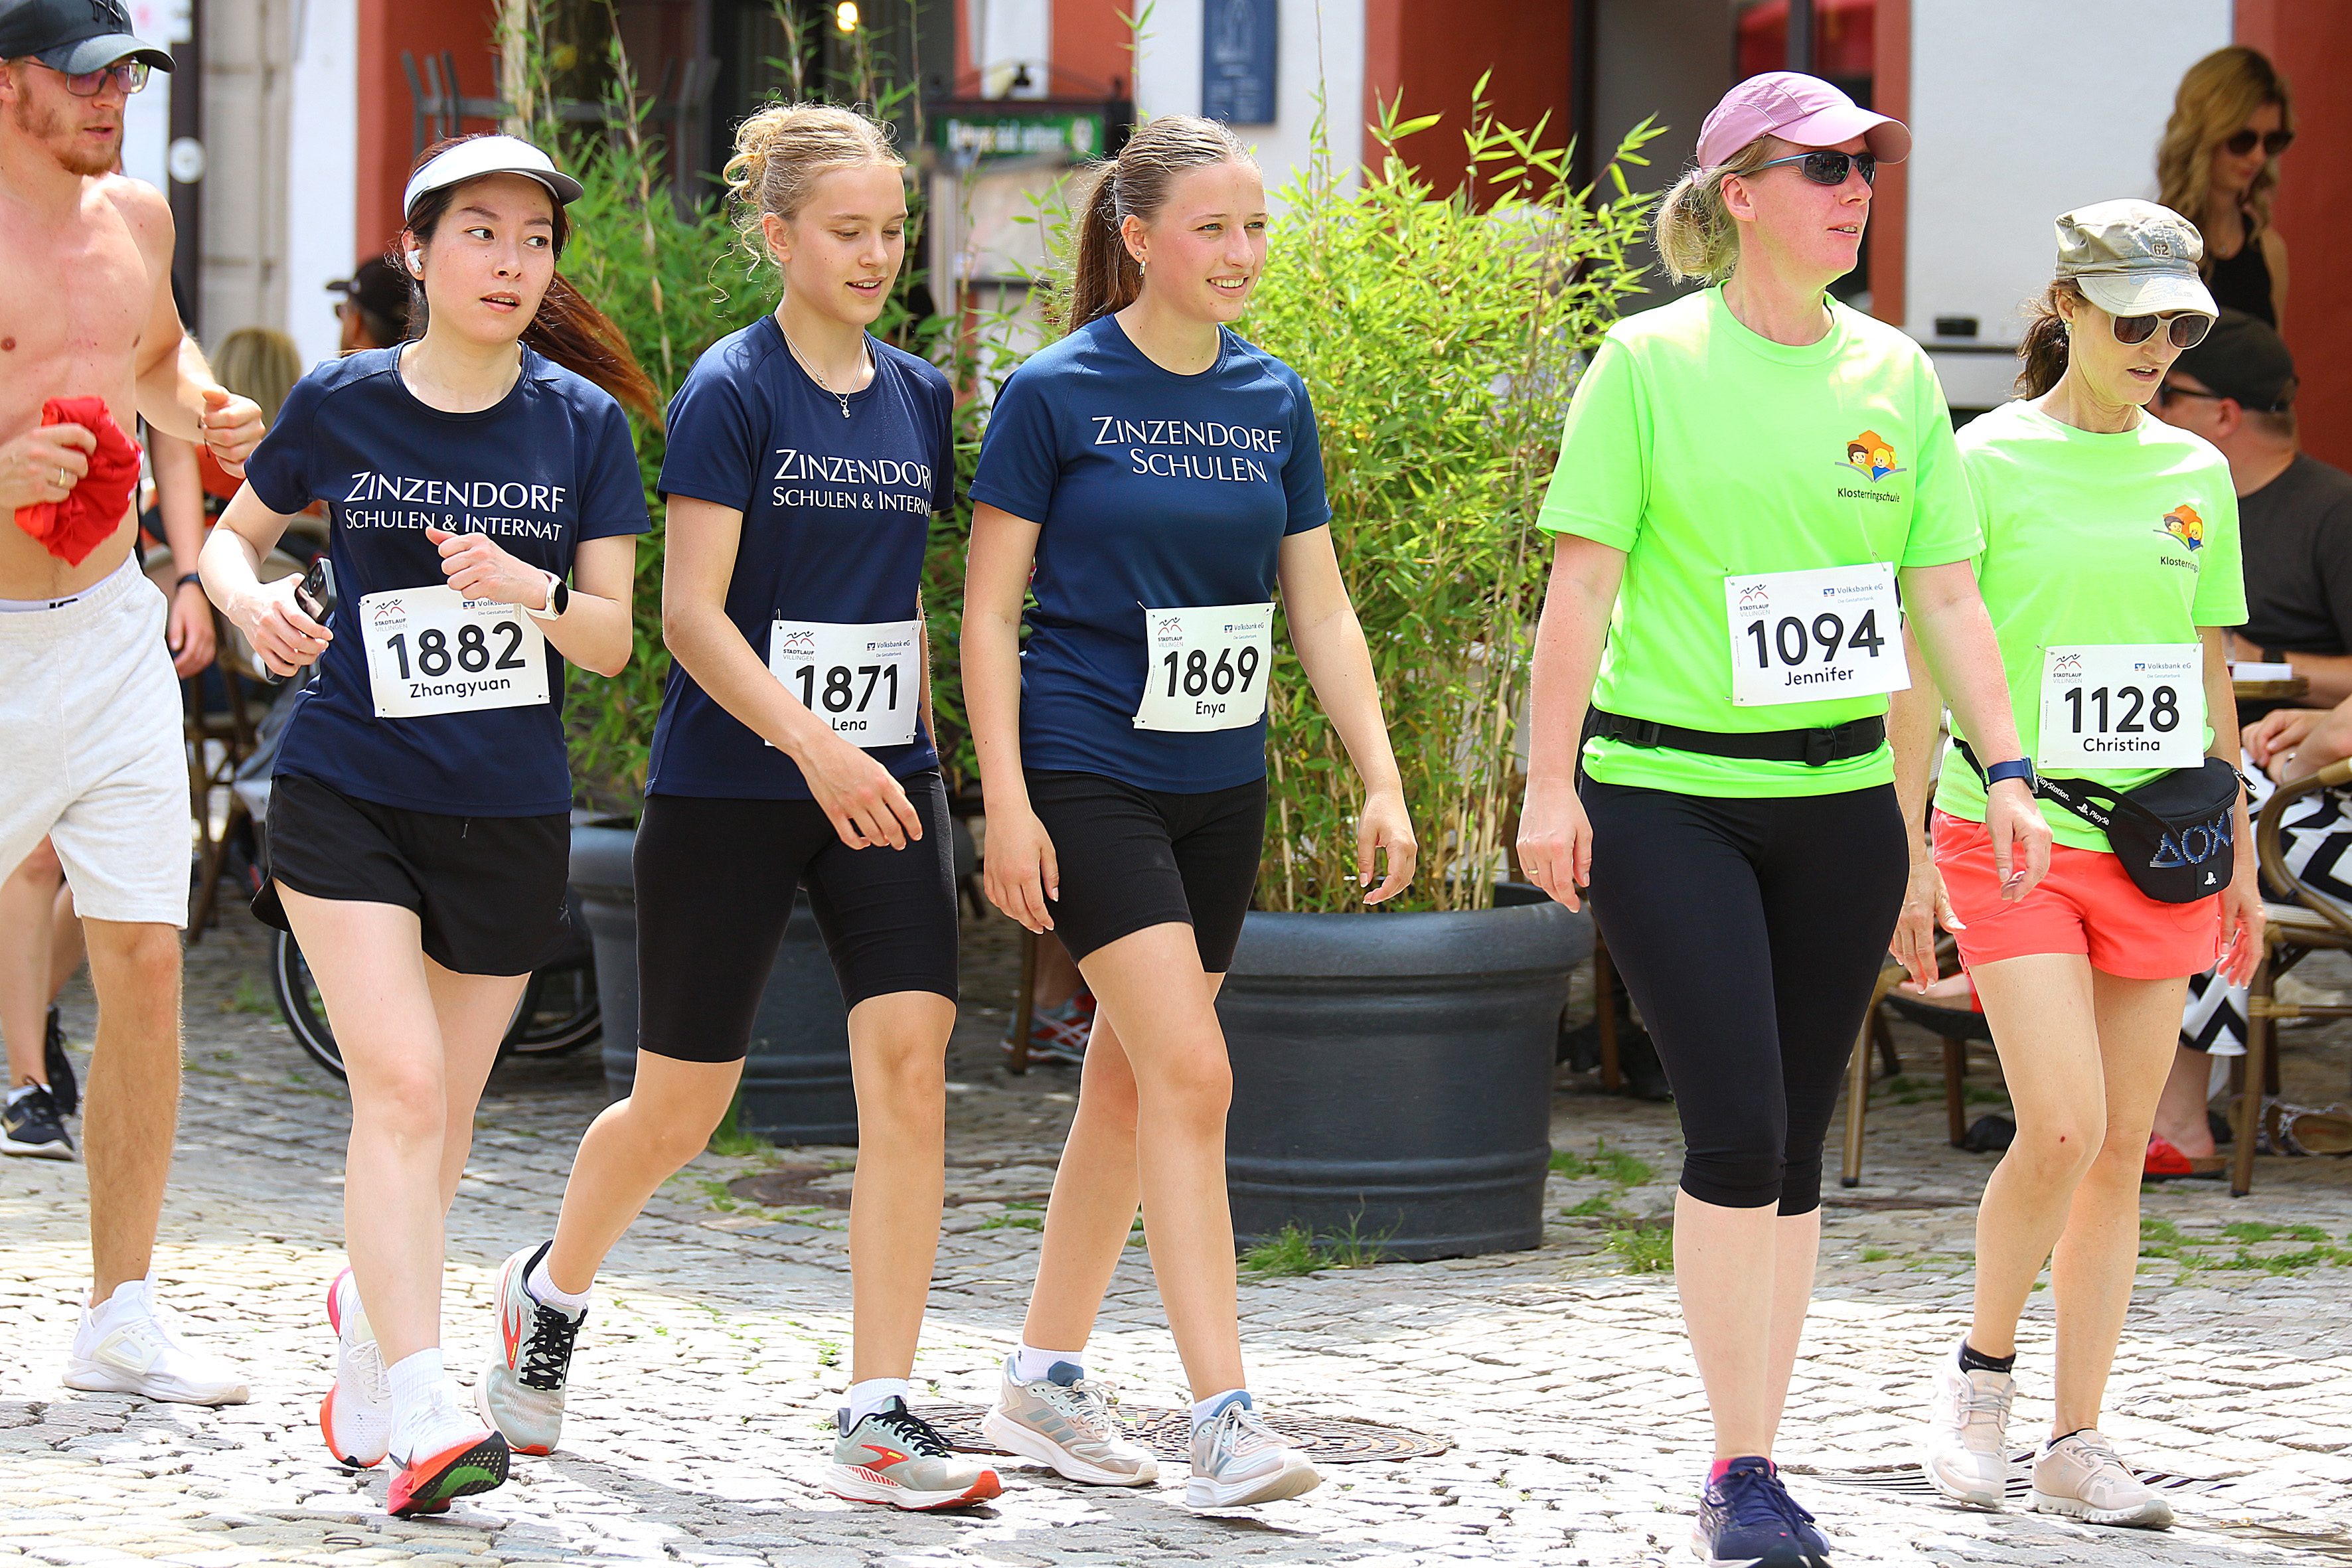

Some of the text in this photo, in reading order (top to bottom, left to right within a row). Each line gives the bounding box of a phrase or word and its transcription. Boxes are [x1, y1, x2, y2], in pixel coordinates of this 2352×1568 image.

[2153, 243, 2169, 256] 62
[1091, 416, 1282, 453] ZINZENDORF
[773, 448, 931, 494] ZINZENDOR
[1130, 447, 1269, 483] SCHULEN
[343, 471, 566, 513] ZINZENDORF
[772, 486, 931, 518] SCHULEN & INTERN
[1838, 487, 1900, 503] Klosterringschule
[345, 509, 563, 542] SCHULEN & INTERNAT
[2160, 556, 2198, 573] Klosterring
[1837, 584, 1873, 594] Volksbank
[477, 597, 514, 607] Volks
[374, 617, 407, 627] STADTLAUF
[1740, 609, 1770, 617] VILLINGEN
[375, 623, 408, 632] VILLINGEN
[1747, 608, 1885, 668] 1094
[386, 621, 526, 680] 1882
[1164, 645, 1259, 697] 1869
[1784, 666, 1854, 686] Jennifer
[409, 678, 510, 698] Zhangyuan
[795, 664, 898, 713] 1871
[1196, 701, 1225, 718] Enya
[2065, 685, 2179, 733] 1128
[832, 717, 867, 731] Lena
[2083, 737, 2160, 752] Christina
